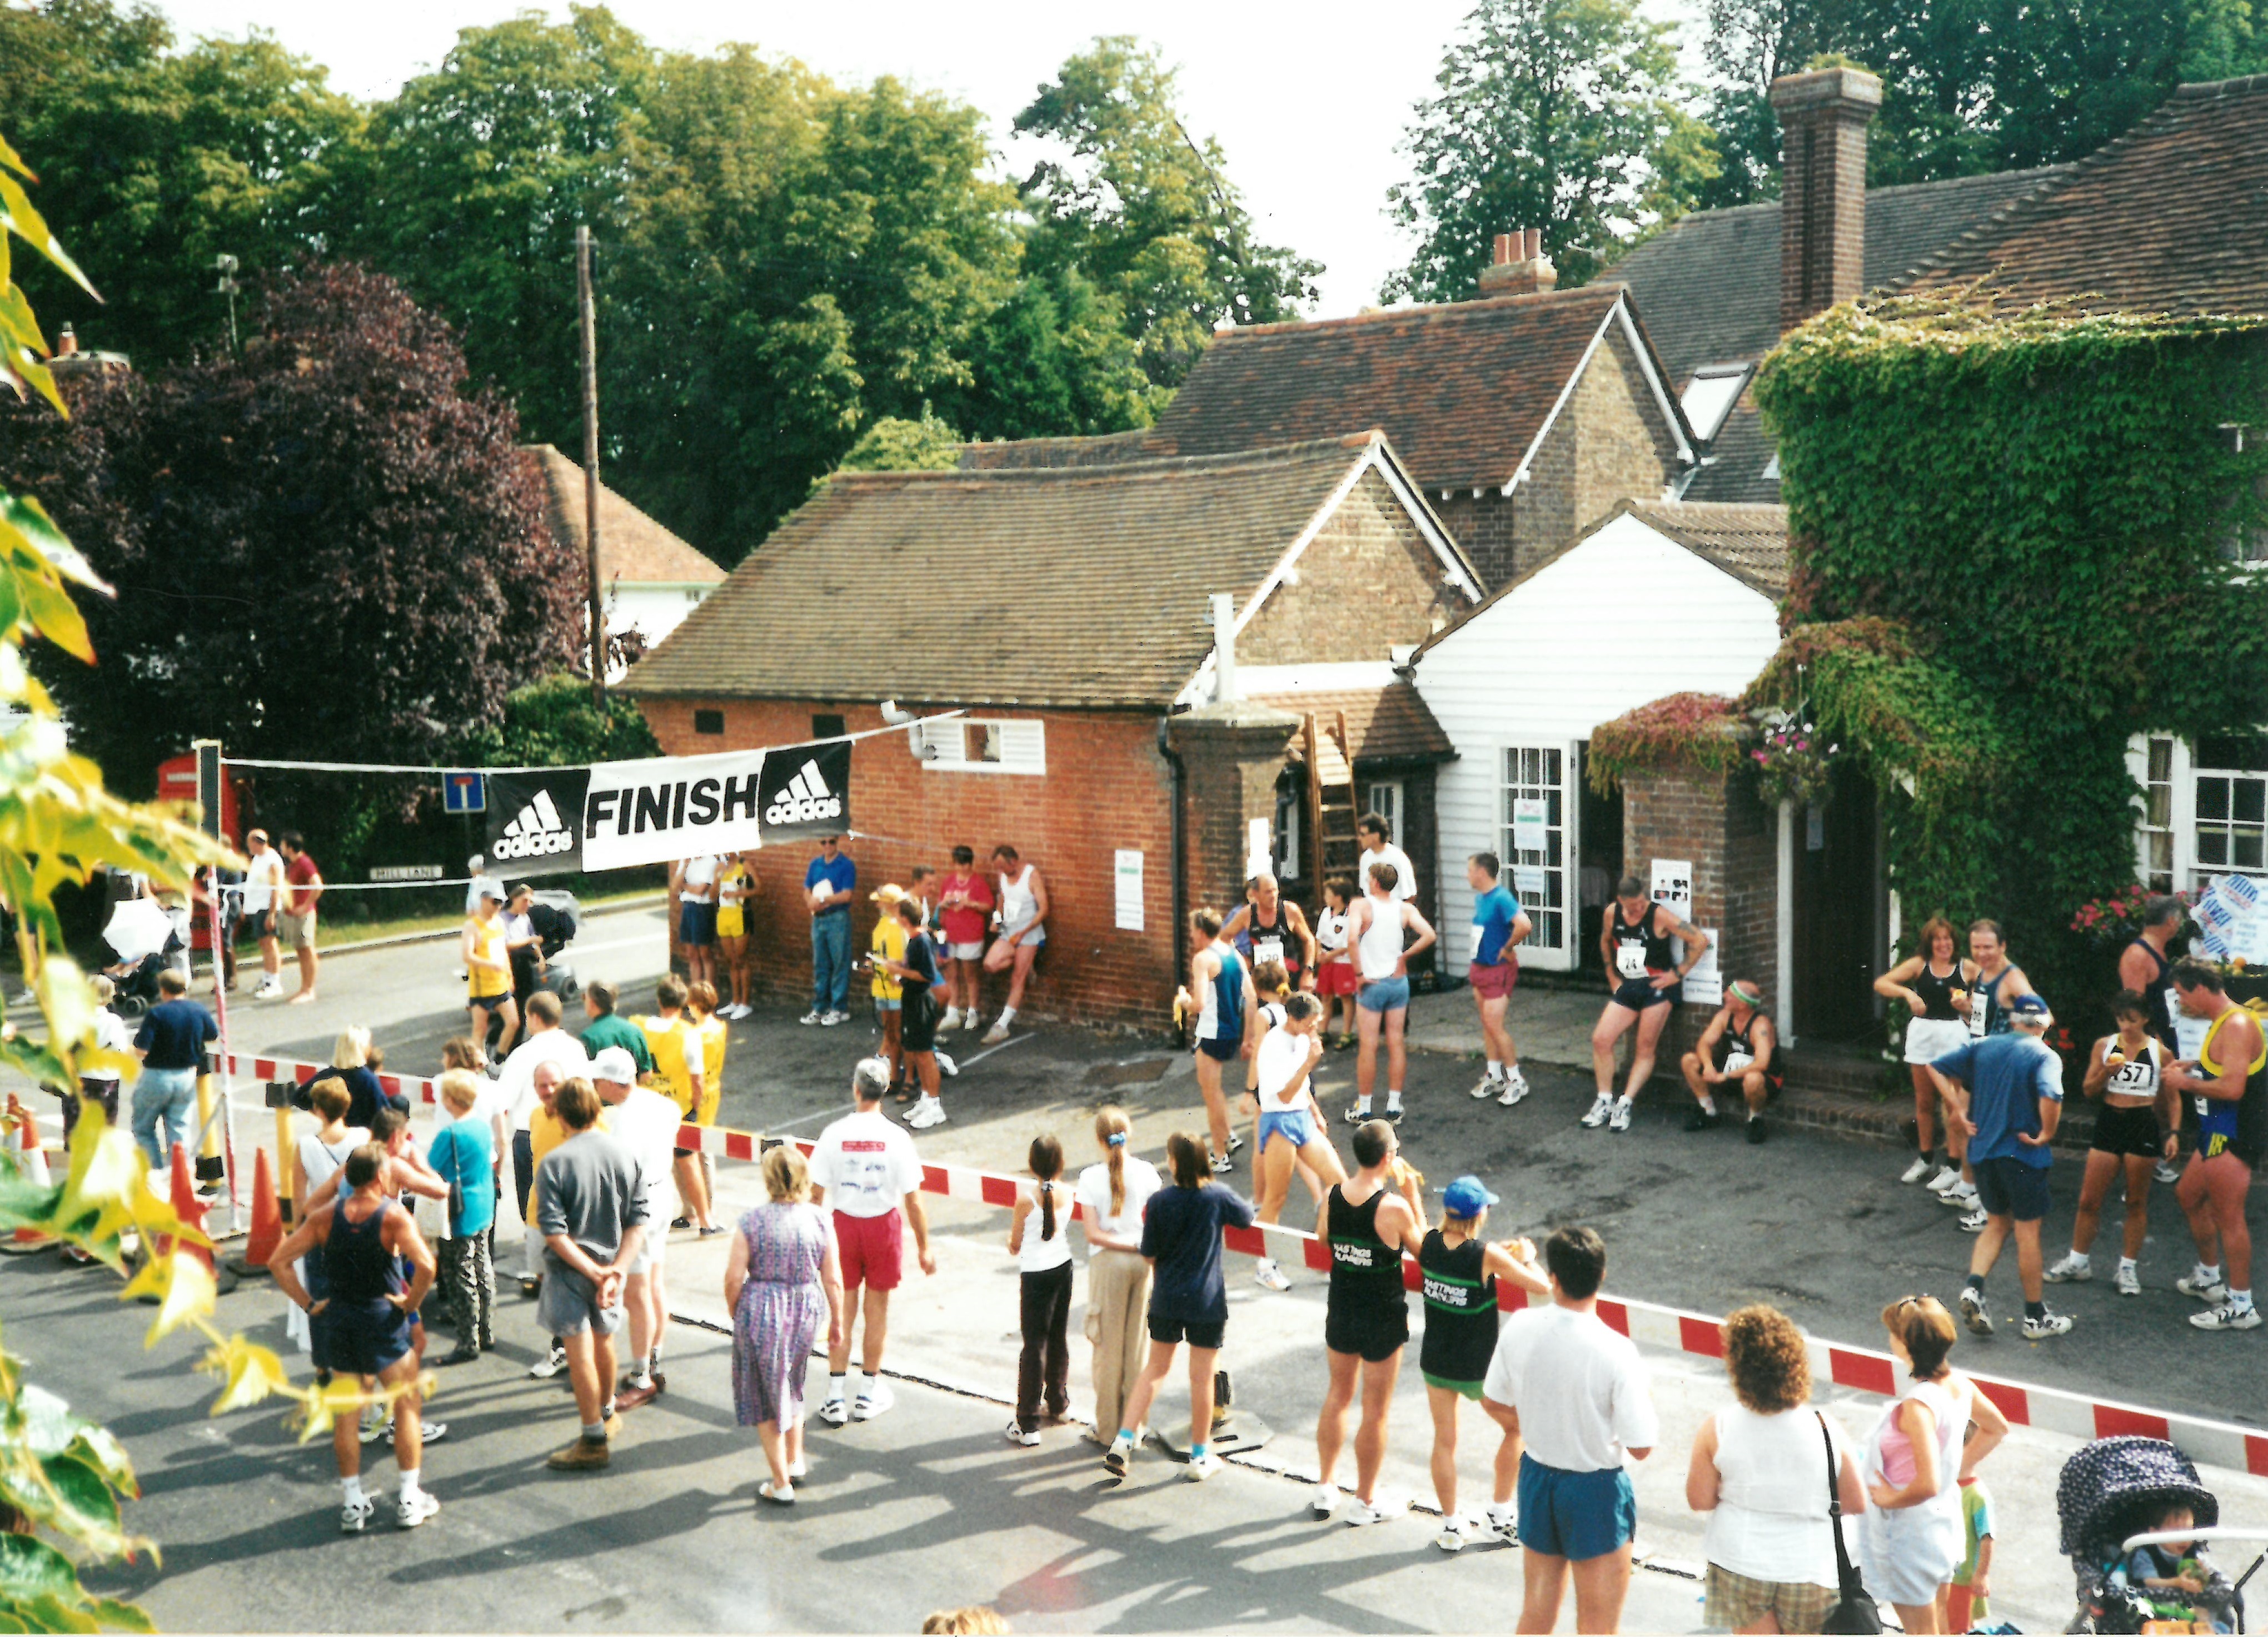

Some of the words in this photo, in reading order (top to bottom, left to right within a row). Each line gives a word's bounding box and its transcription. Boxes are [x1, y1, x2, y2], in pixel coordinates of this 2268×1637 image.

[586, 774, 759, 839] FINISH
[766, 797, 841, 825] adidas
[494, 829, 574, 860] adidas
